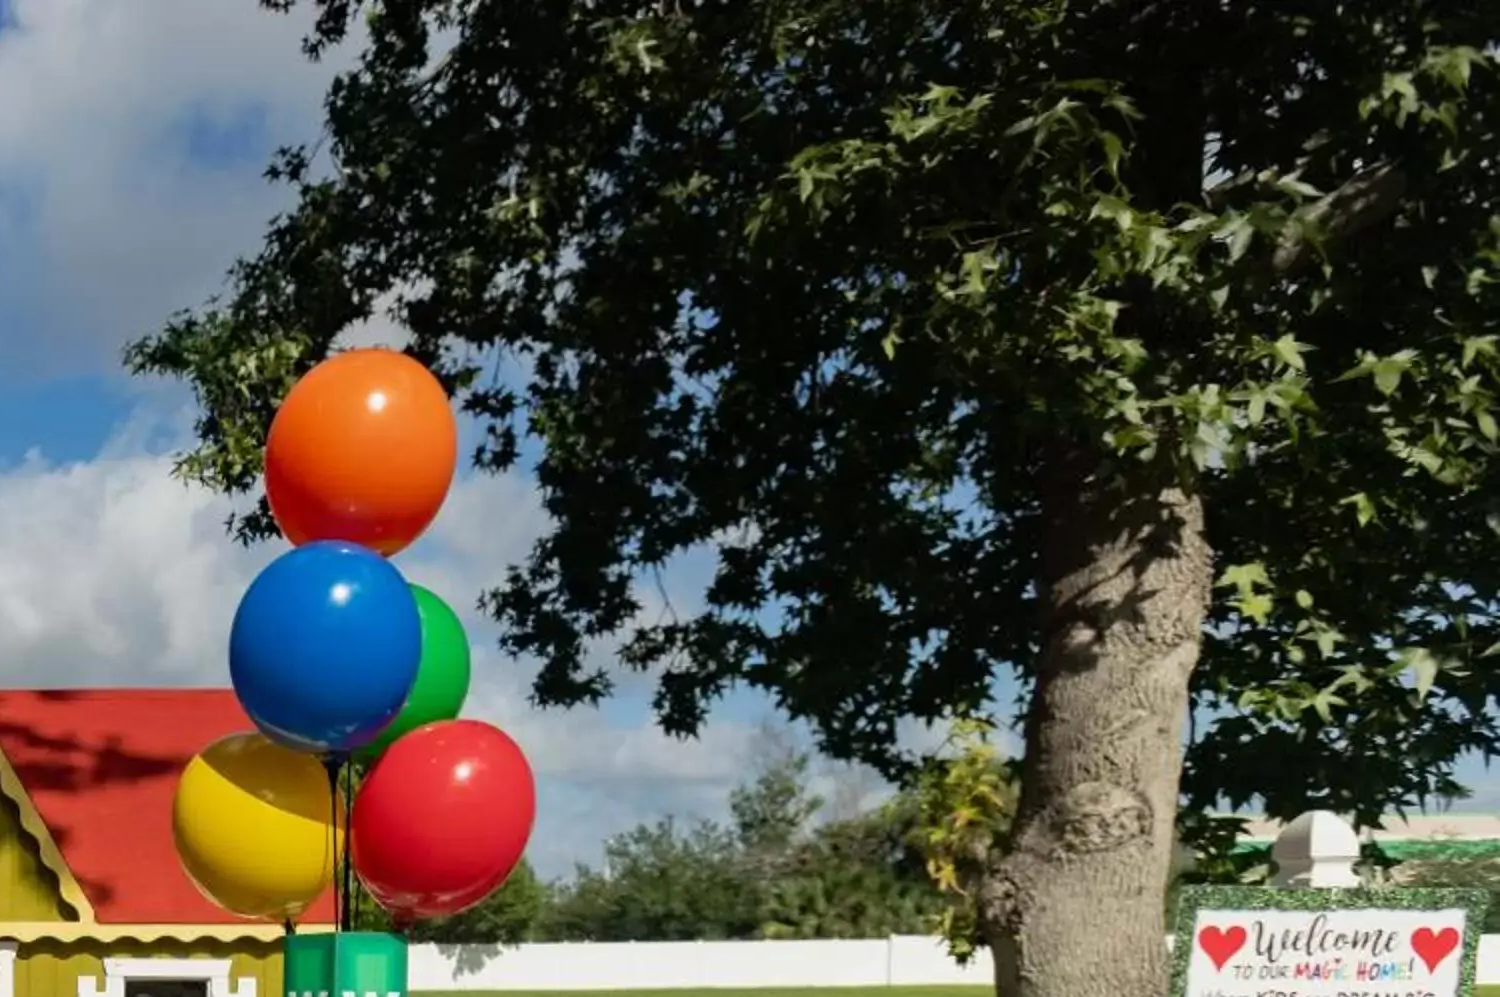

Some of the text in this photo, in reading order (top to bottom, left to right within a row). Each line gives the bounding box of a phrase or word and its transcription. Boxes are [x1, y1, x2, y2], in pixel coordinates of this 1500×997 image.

[1251, 913, 1399, 962] Welcome
[1232, 964, 1256, 979] TO
[1258, 964, 1289, 979] OUR
[1356, 957, 1414, 981] HOME!
